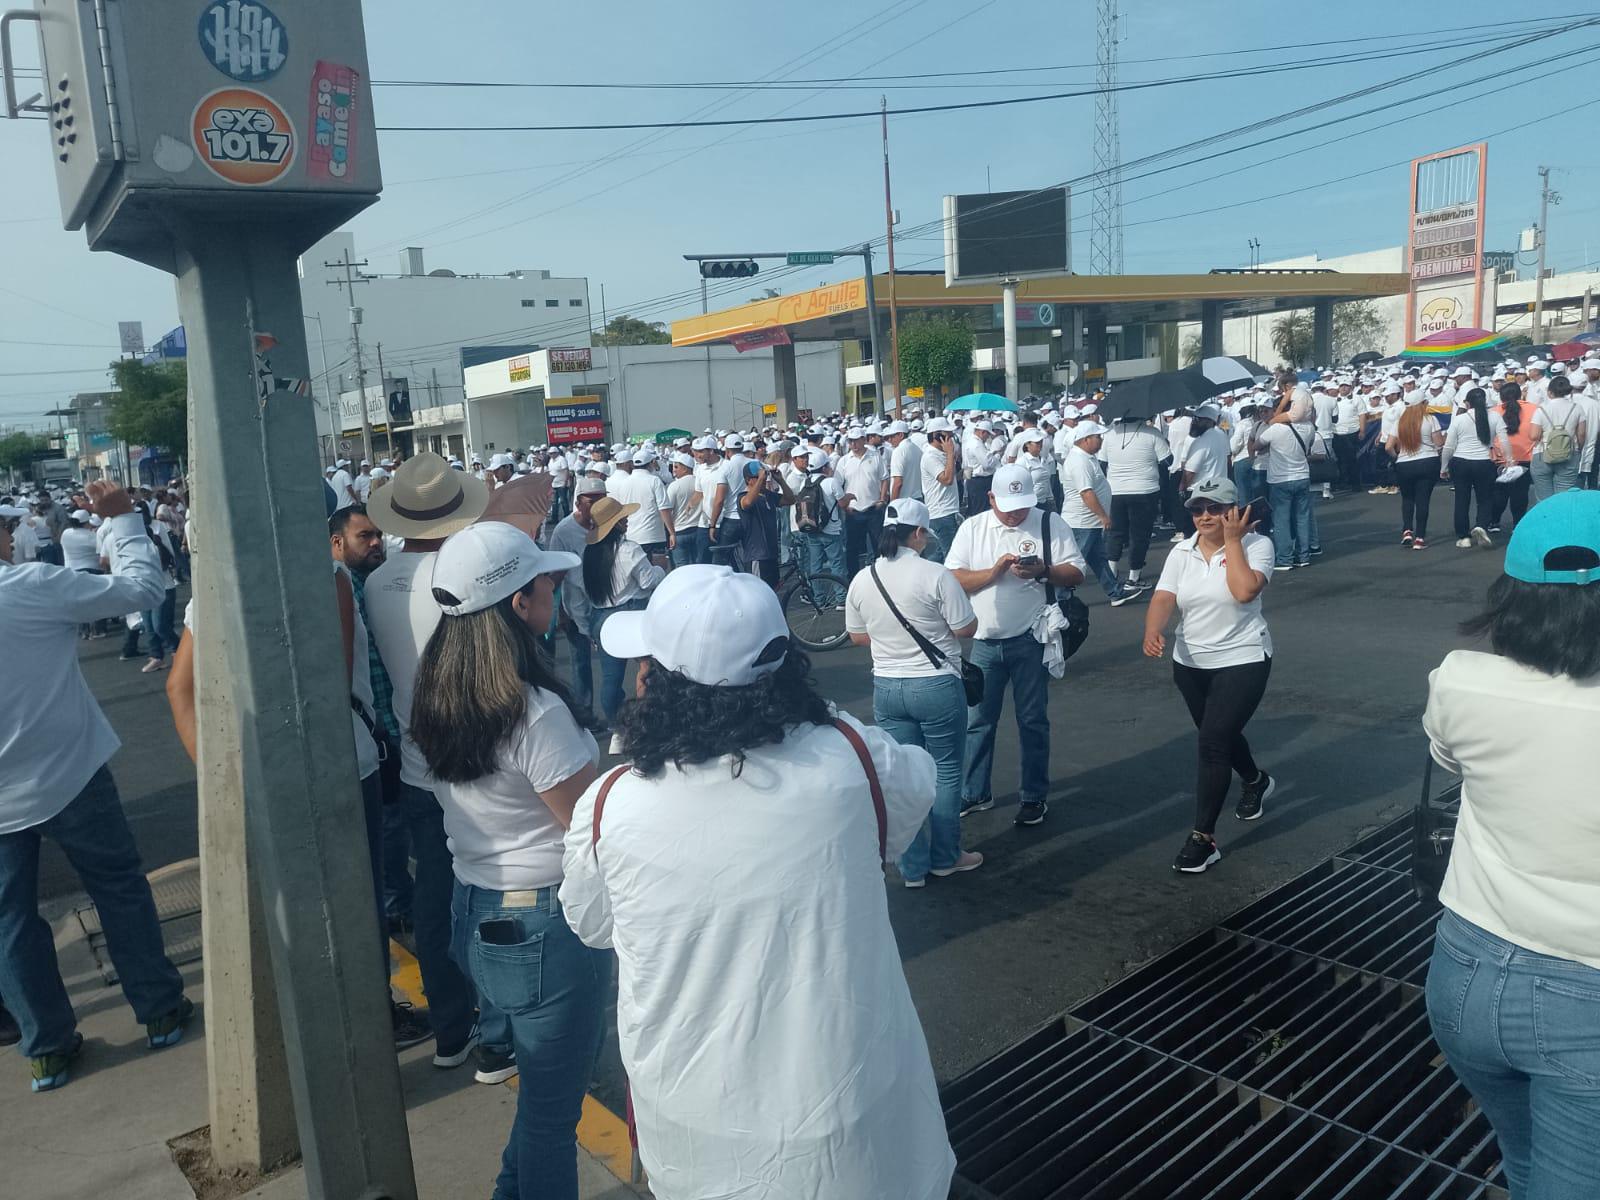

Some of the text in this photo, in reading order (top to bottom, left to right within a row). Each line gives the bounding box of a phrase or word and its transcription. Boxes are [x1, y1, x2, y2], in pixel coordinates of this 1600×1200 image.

[204, 129, 289, 163] 101.7
[1421, 243, 1465, 260] DIESEL
[1413, 256, 1475, 278] PREMIUM 91
[578, 408, 596, 417] 20.99
